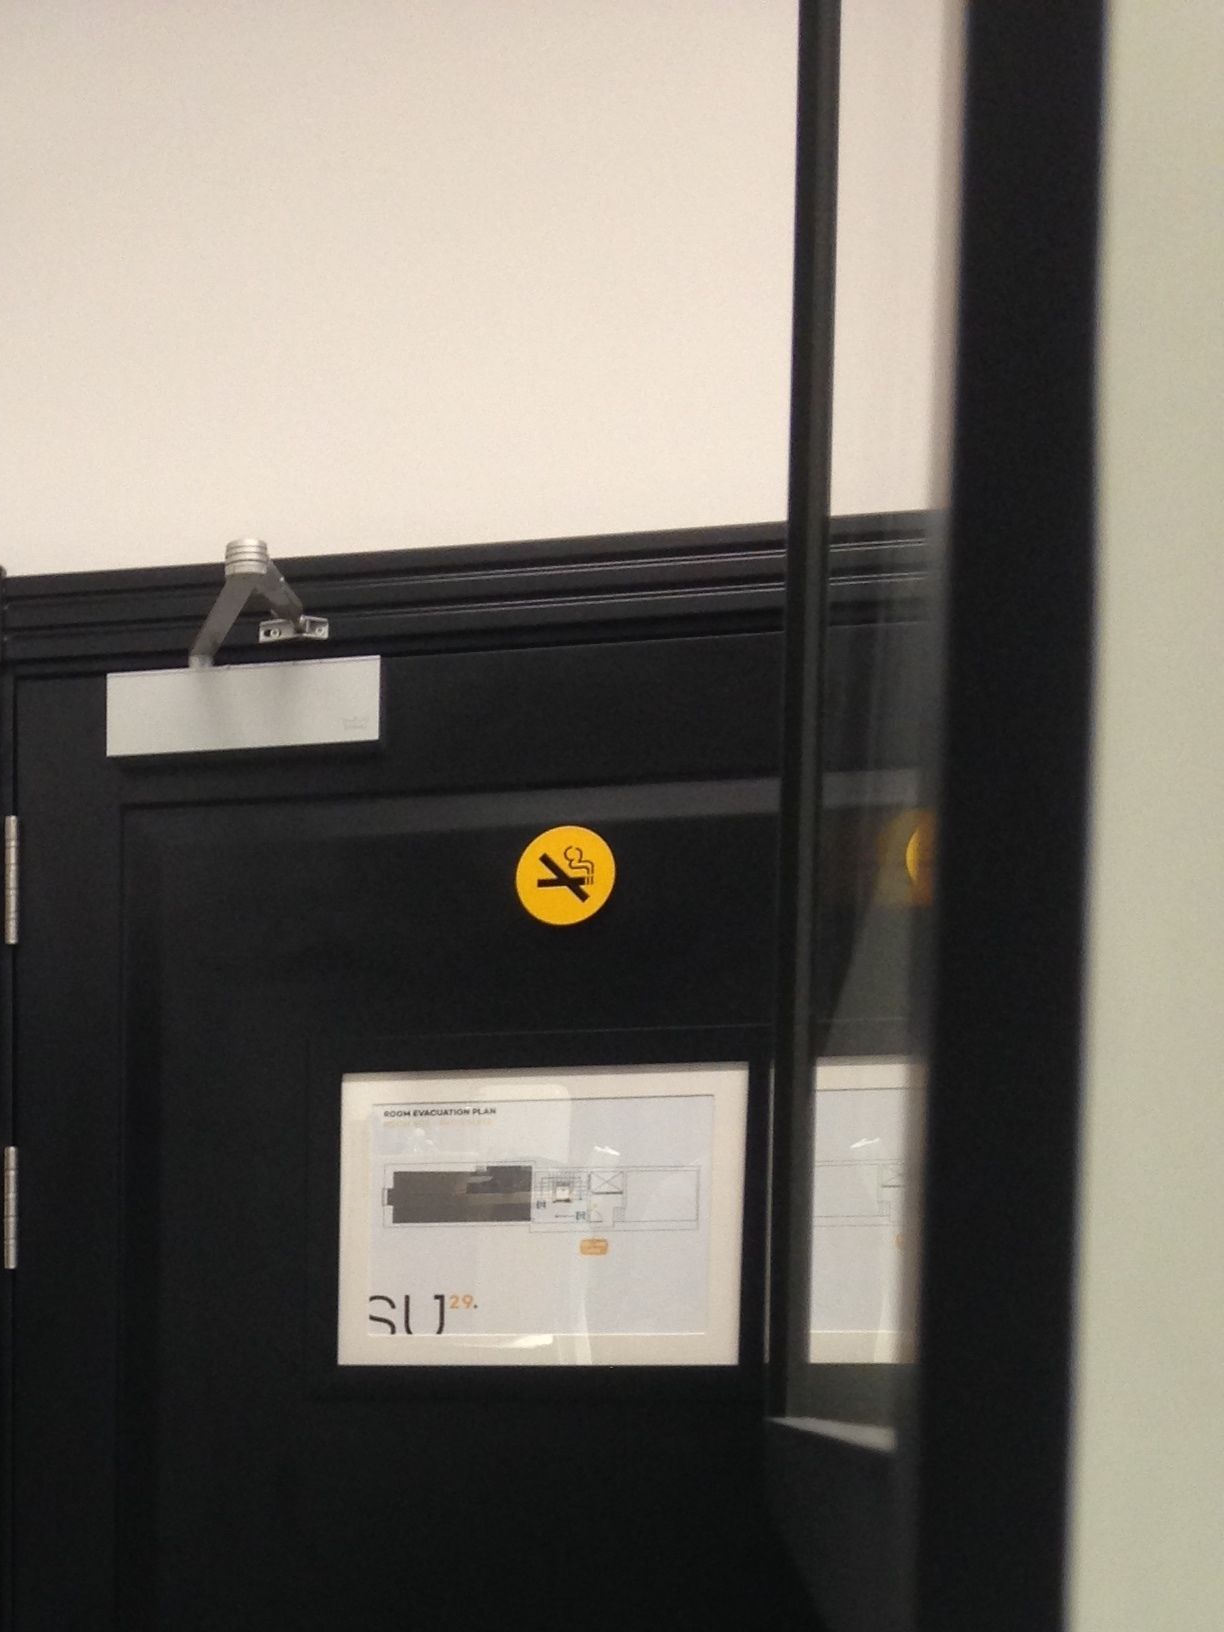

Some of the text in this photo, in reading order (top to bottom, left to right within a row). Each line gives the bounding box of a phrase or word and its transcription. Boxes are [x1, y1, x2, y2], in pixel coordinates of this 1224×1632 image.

[383, 1107, 497, 1118] ROOM EVACUATION PLAN
